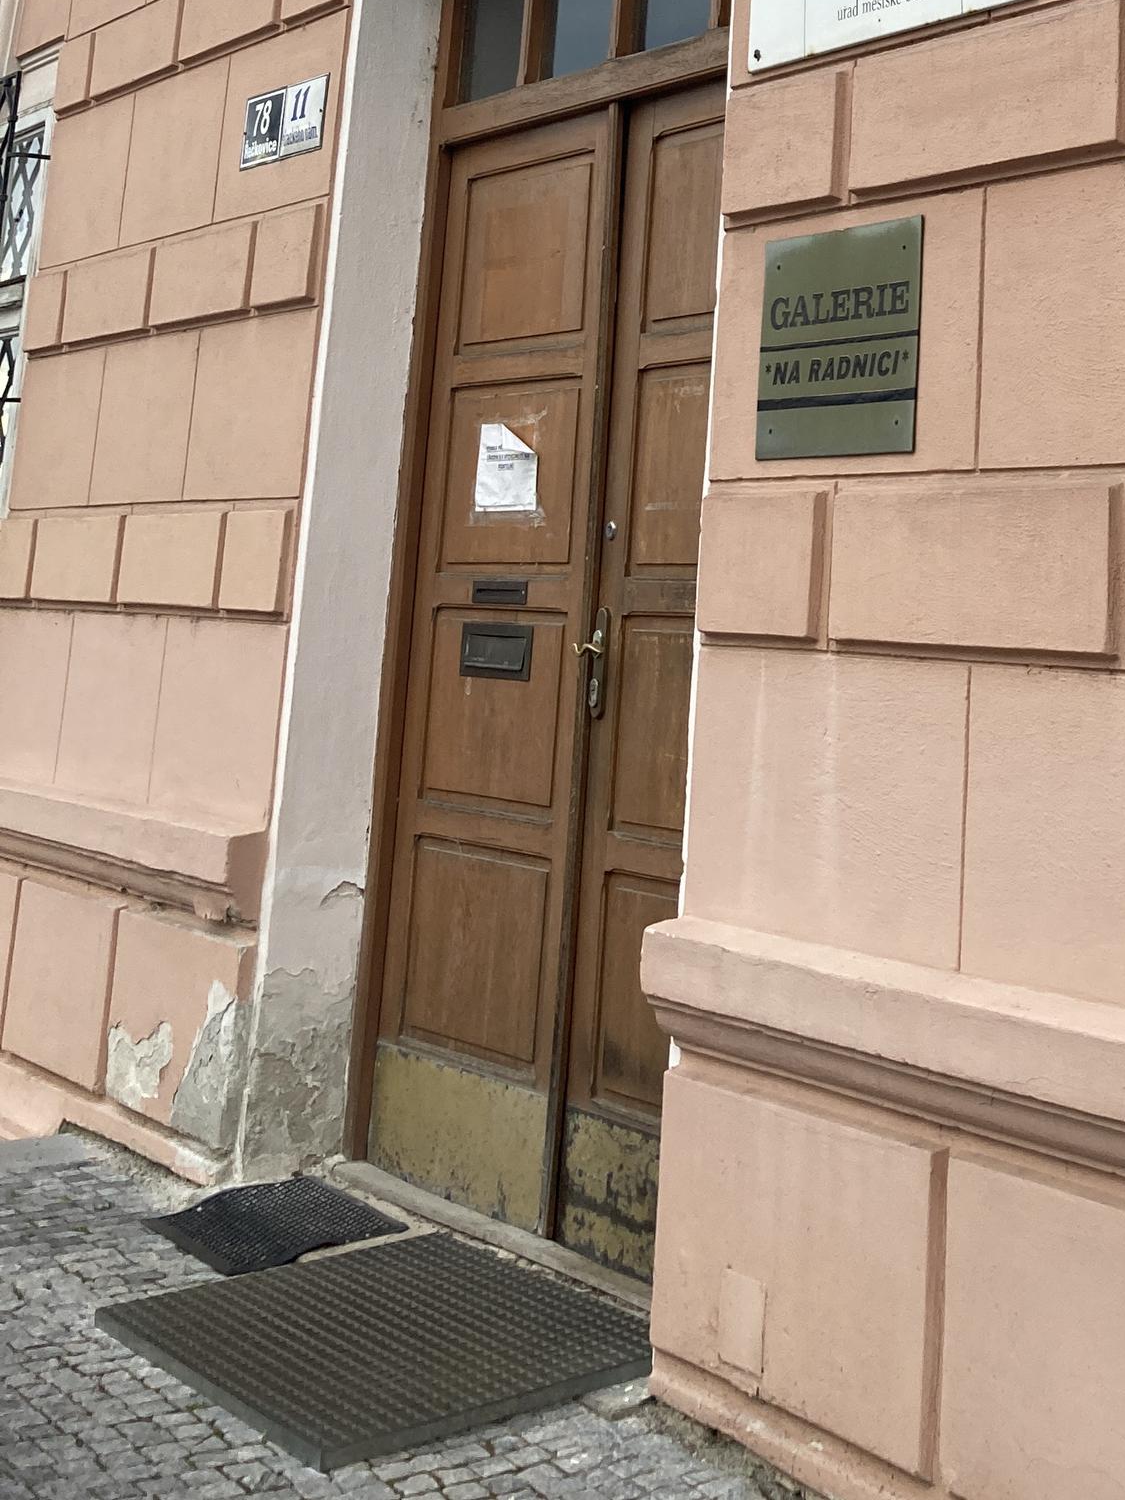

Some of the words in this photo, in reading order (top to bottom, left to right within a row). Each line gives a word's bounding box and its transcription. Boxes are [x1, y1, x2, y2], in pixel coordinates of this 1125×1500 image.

[253, 100, 273, 137] 78
[291, 85, 311, 121] 11
[770, 281, 911, 330] GALERIE
